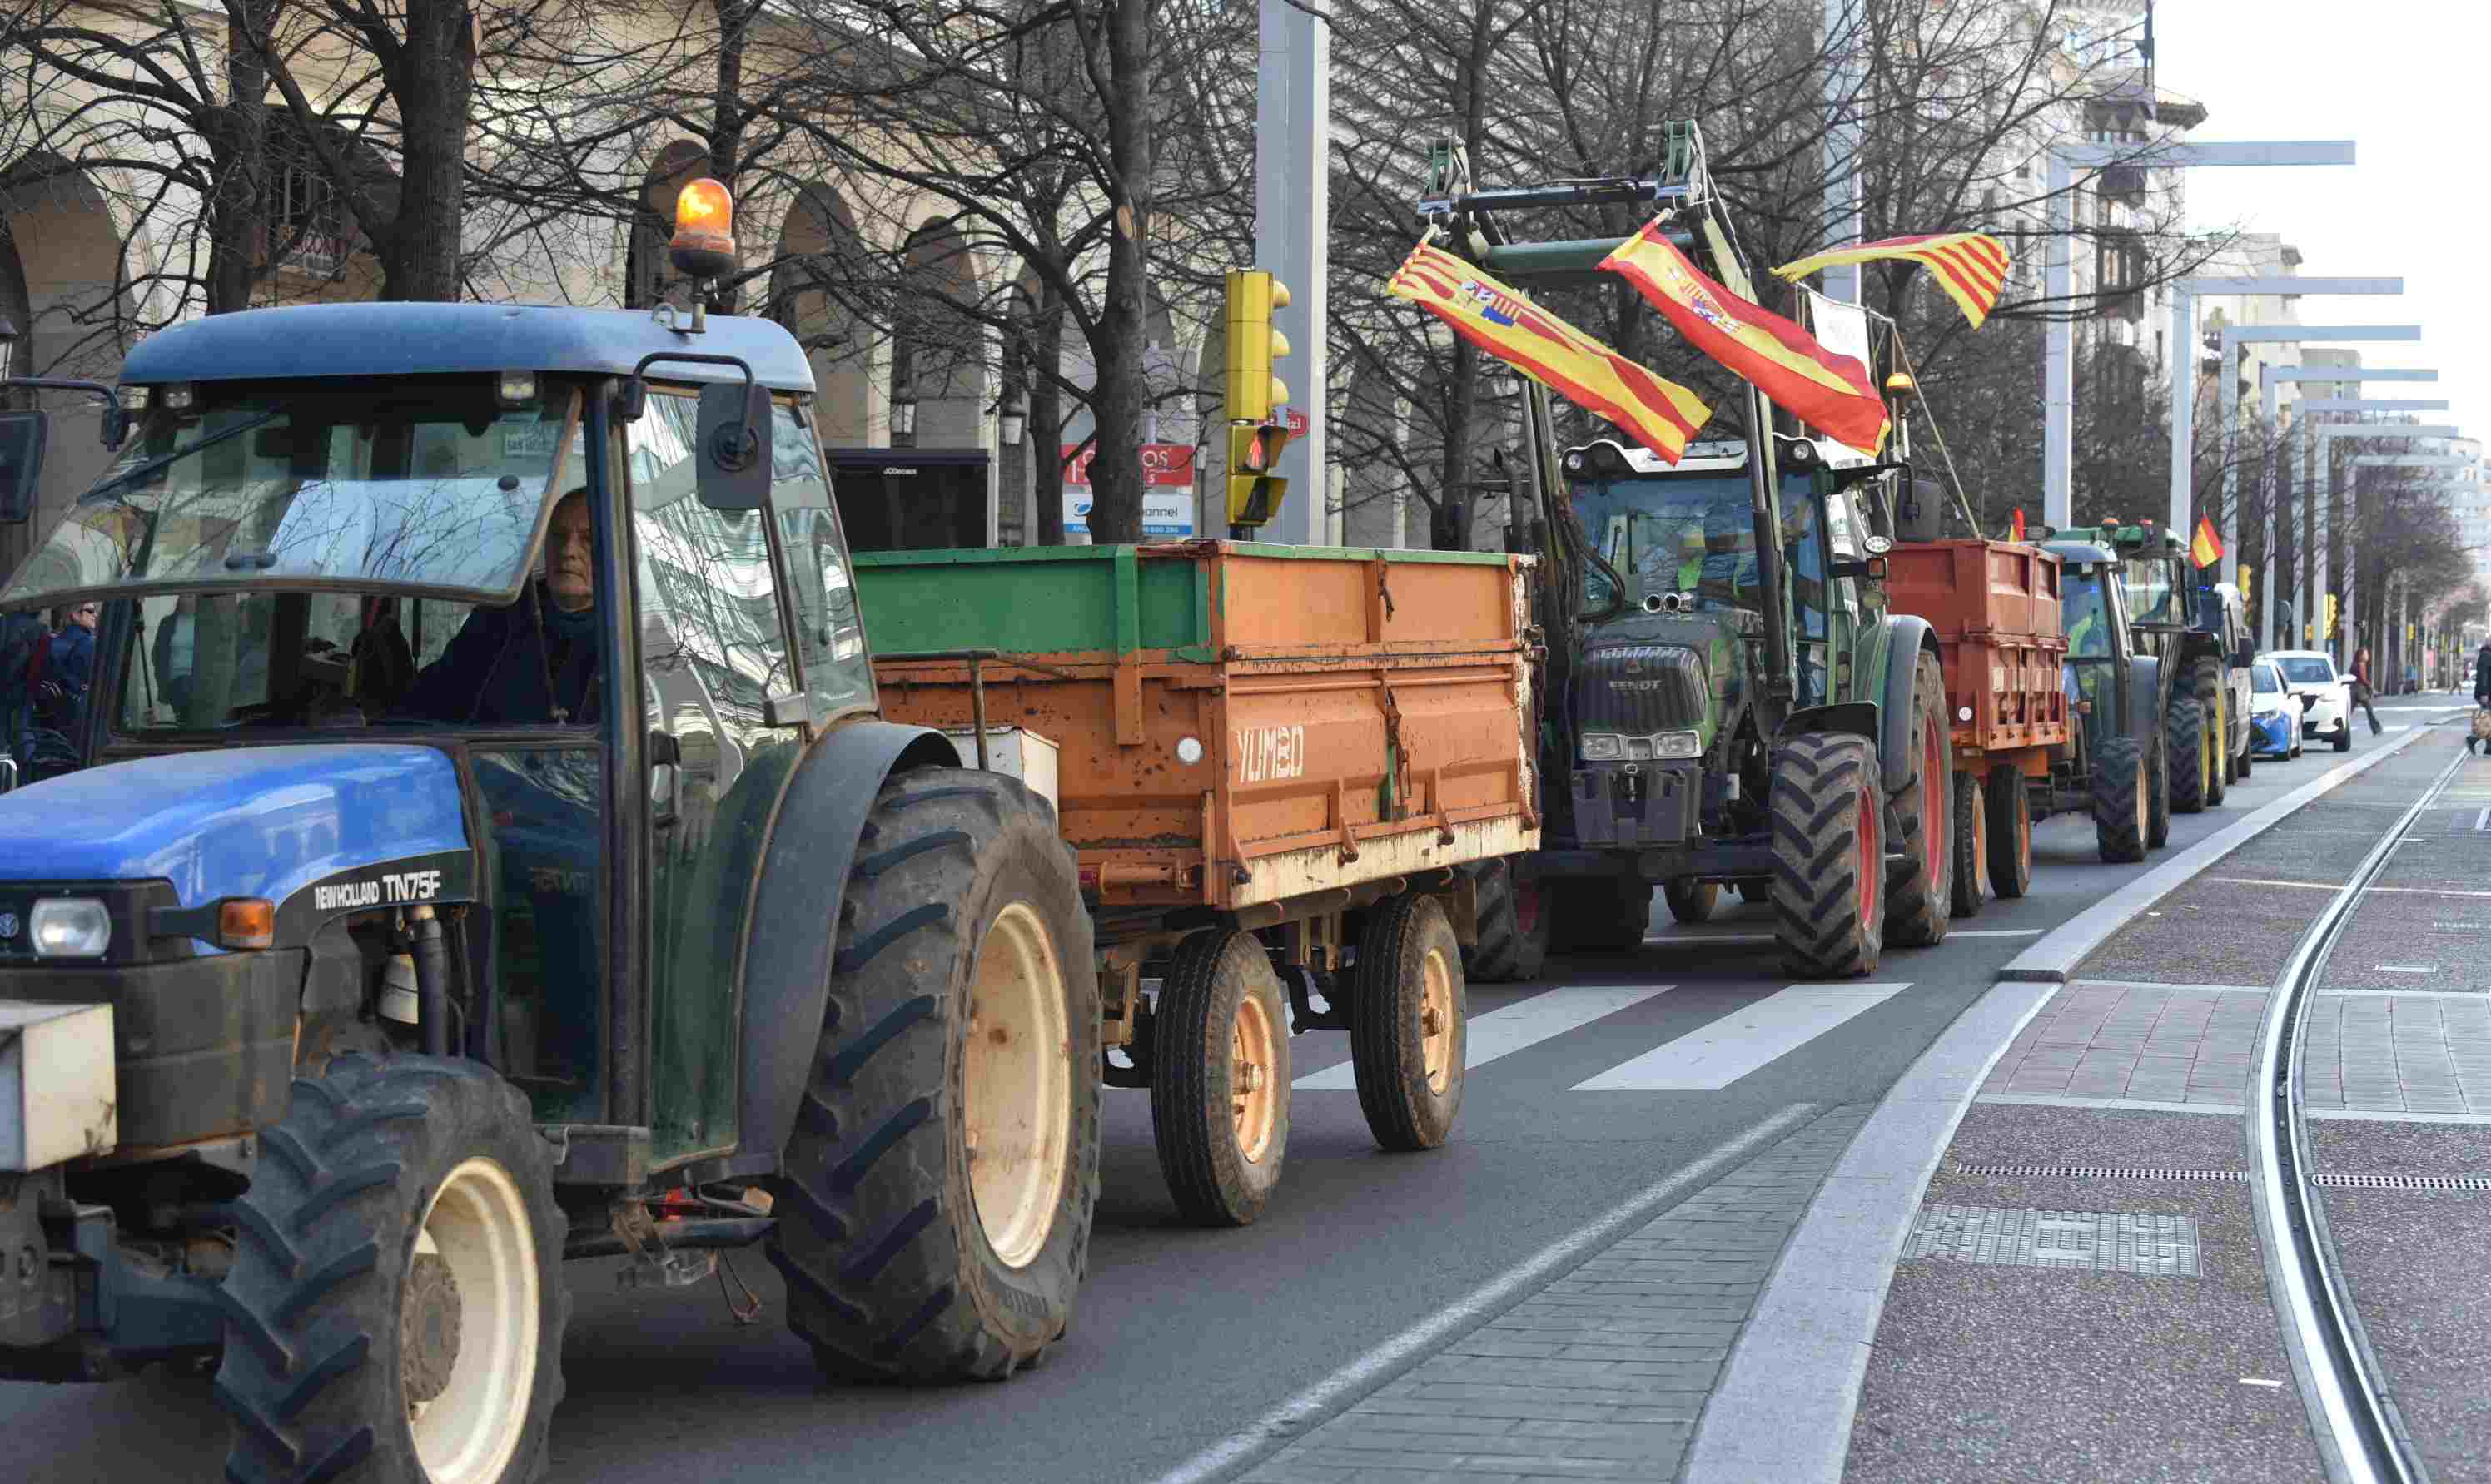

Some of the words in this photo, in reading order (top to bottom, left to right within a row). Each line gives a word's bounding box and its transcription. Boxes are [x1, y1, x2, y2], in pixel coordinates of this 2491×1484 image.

[1144, 505, 1178, 518] annel
[1608, 680, 1662, 690] FENDT
[1237, 726, 1304, 783] YUMBO
[315, 886, 336, 911] NEW
[336, 881, 380, 906] HOLLAND
[382, 871, 440, 902] TN75F
